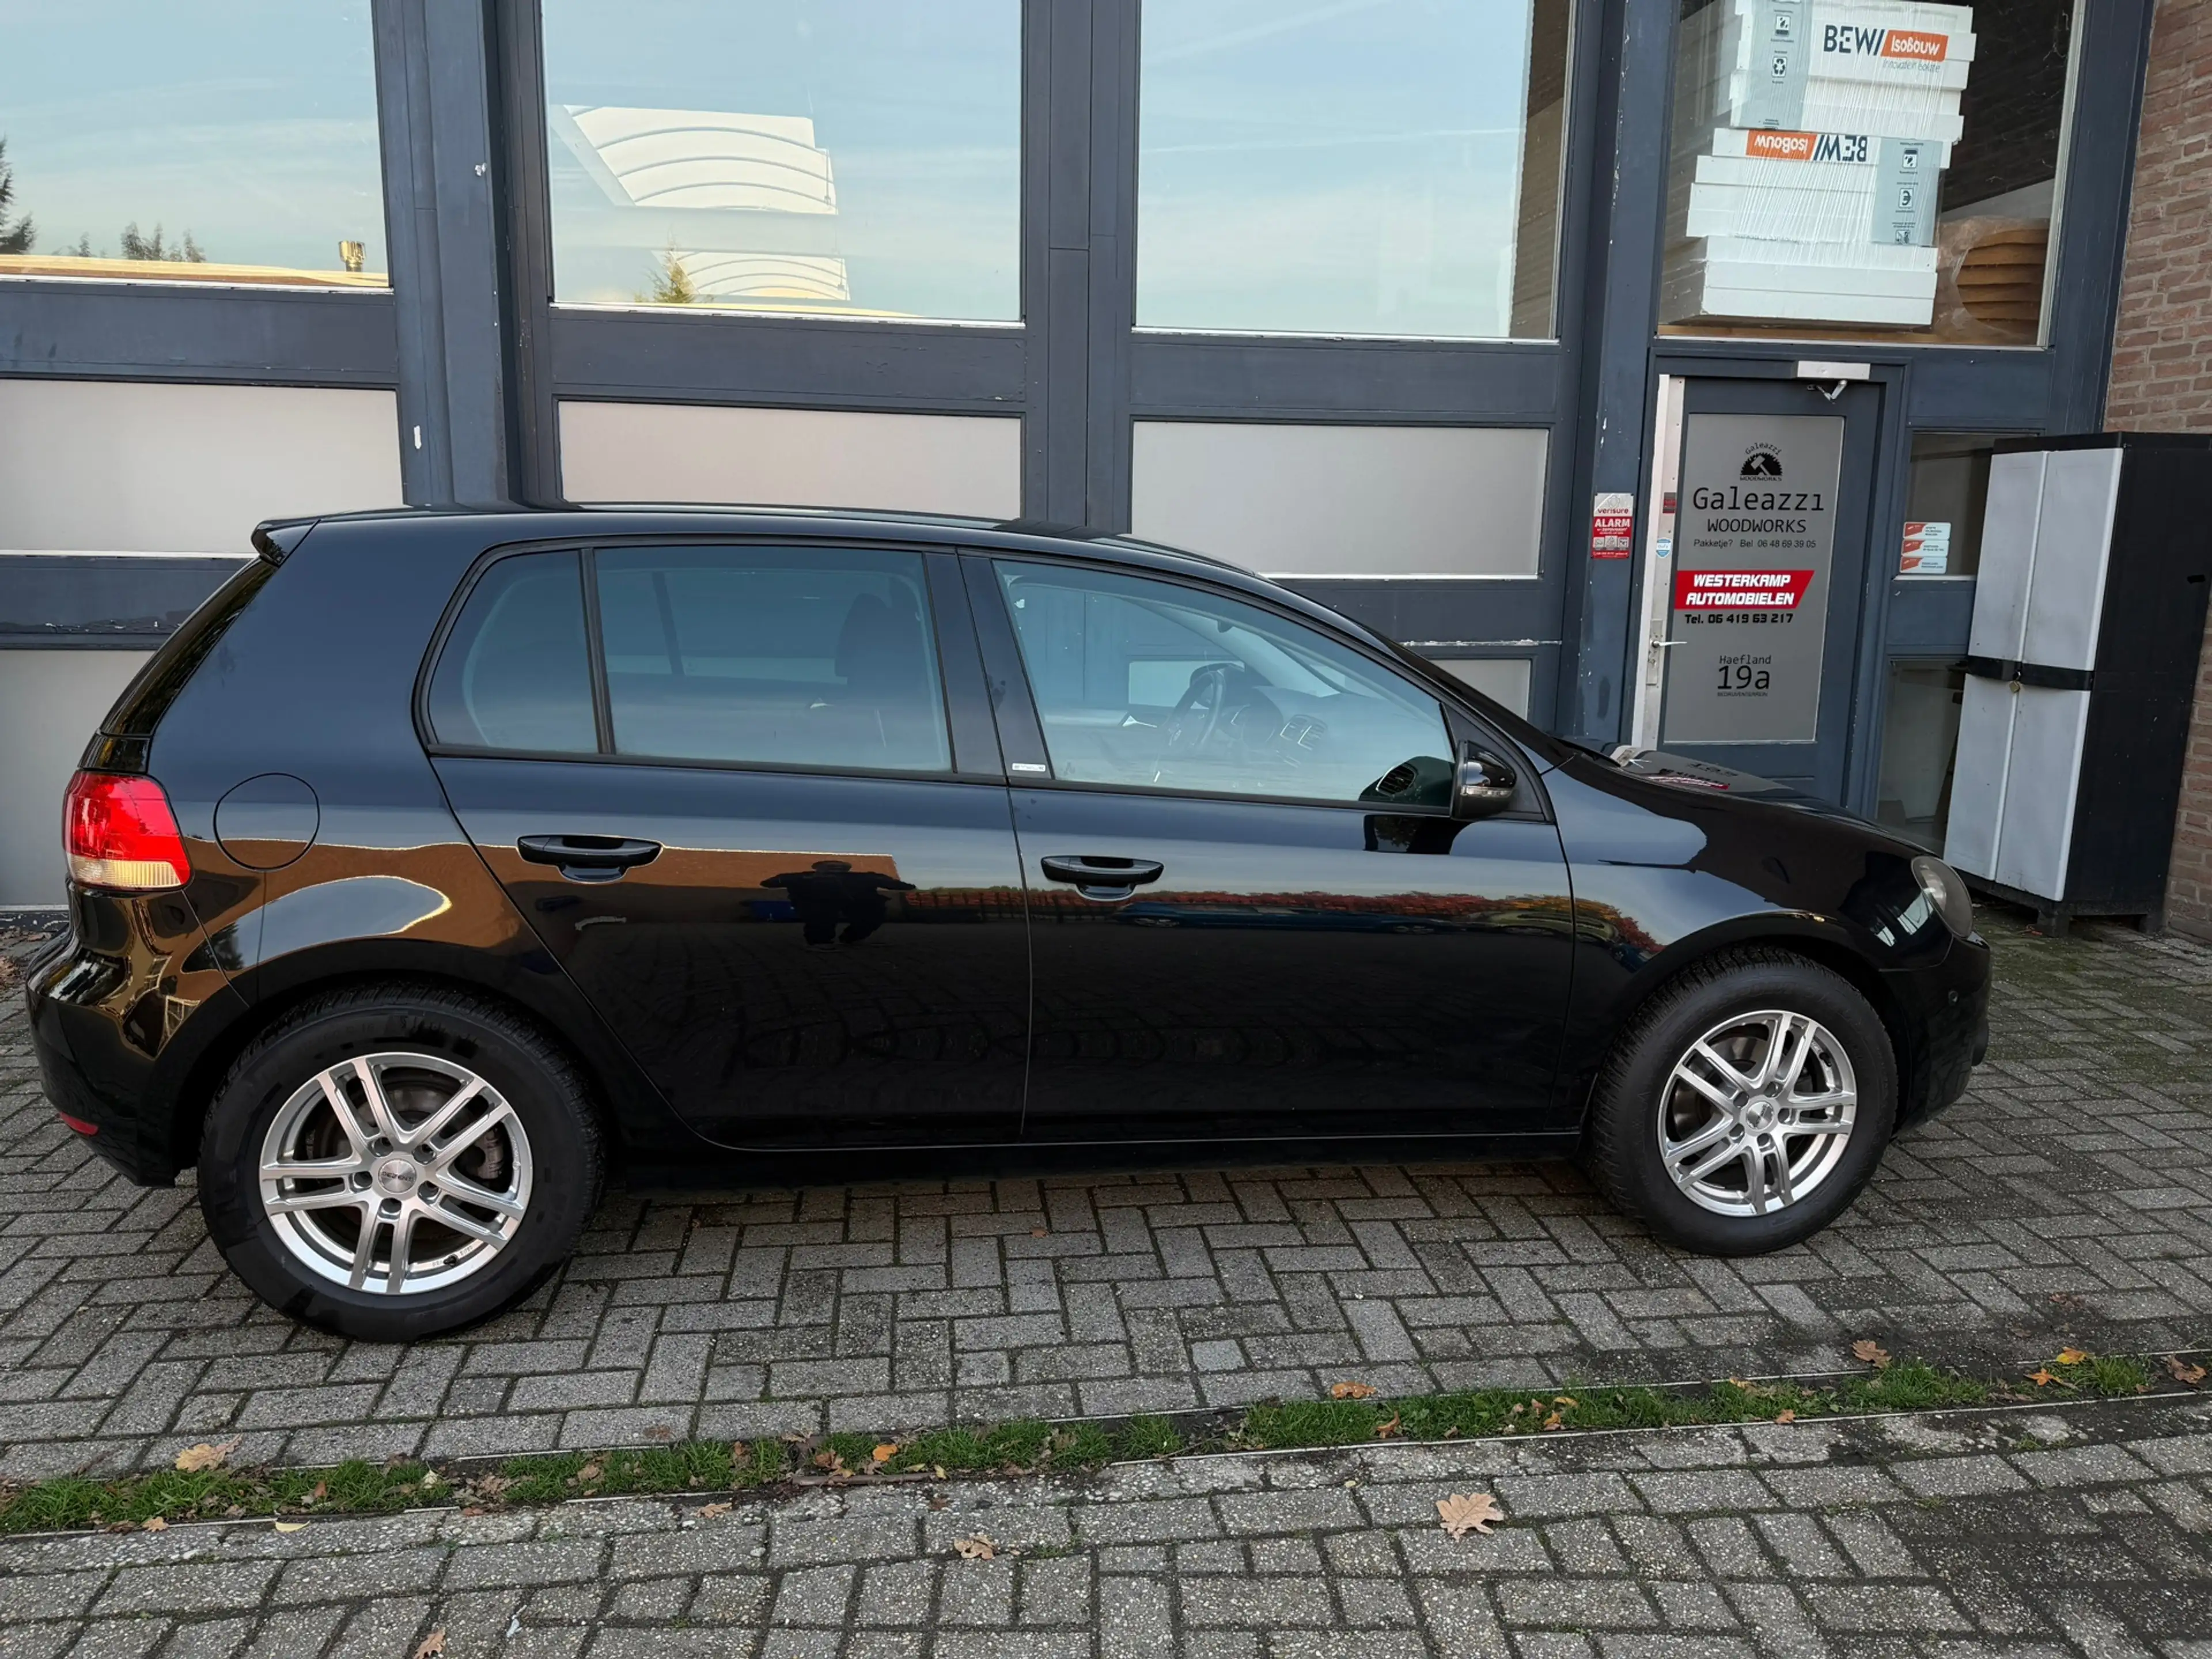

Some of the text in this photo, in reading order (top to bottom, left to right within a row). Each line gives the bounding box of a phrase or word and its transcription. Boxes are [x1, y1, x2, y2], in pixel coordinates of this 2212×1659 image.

[1824, 25, 1885, 56] BEWI
[1594, 518, 1630, 528] ALARM
[1707, 518, 1806, 533] WOODWORKS
[1693, 539, 1733, 549] Pakketje?
[1740, 539, 1753, 547] Bel
[1757, 539, 1768, 547] 06
[1770, 539, 1780, 547] 48
[1794, 540, 1804, 548] 39
[1806, 540, 1816, 548] 05
[1694, 574, 1791, 587] WESTERKAMP
[1685, 592, 1794, 605] AUTOMOBIELEN
[1684, 613, 1794, 623] Tel. 06 419 63 217
[1719, 654, 1772, 664] Haefland
[1717, 665, 1770, 690] 19a
